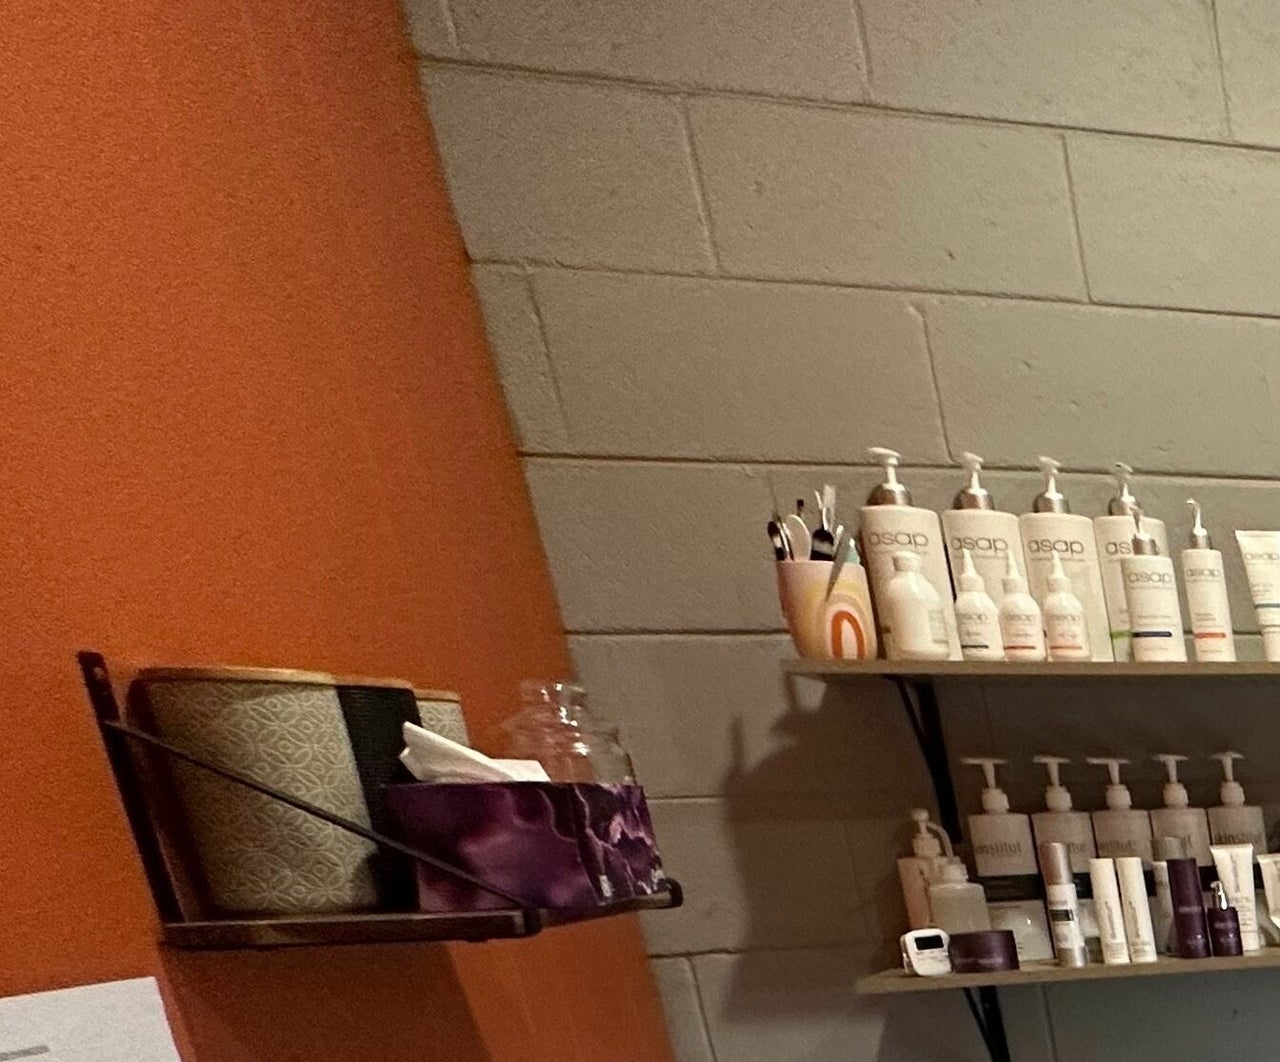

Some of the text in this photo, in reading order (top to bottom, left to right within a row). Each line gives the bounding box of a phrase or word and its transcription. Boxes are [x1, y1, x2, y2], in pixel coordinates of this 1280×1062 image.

[868, 531, 929, 550] asap
[950, 536, 1008, 554] asap
[1027, 538, 1084, 556] asap
[1105, 540, 1132, 555] as
[1128, 571, 1172, 584] asap
